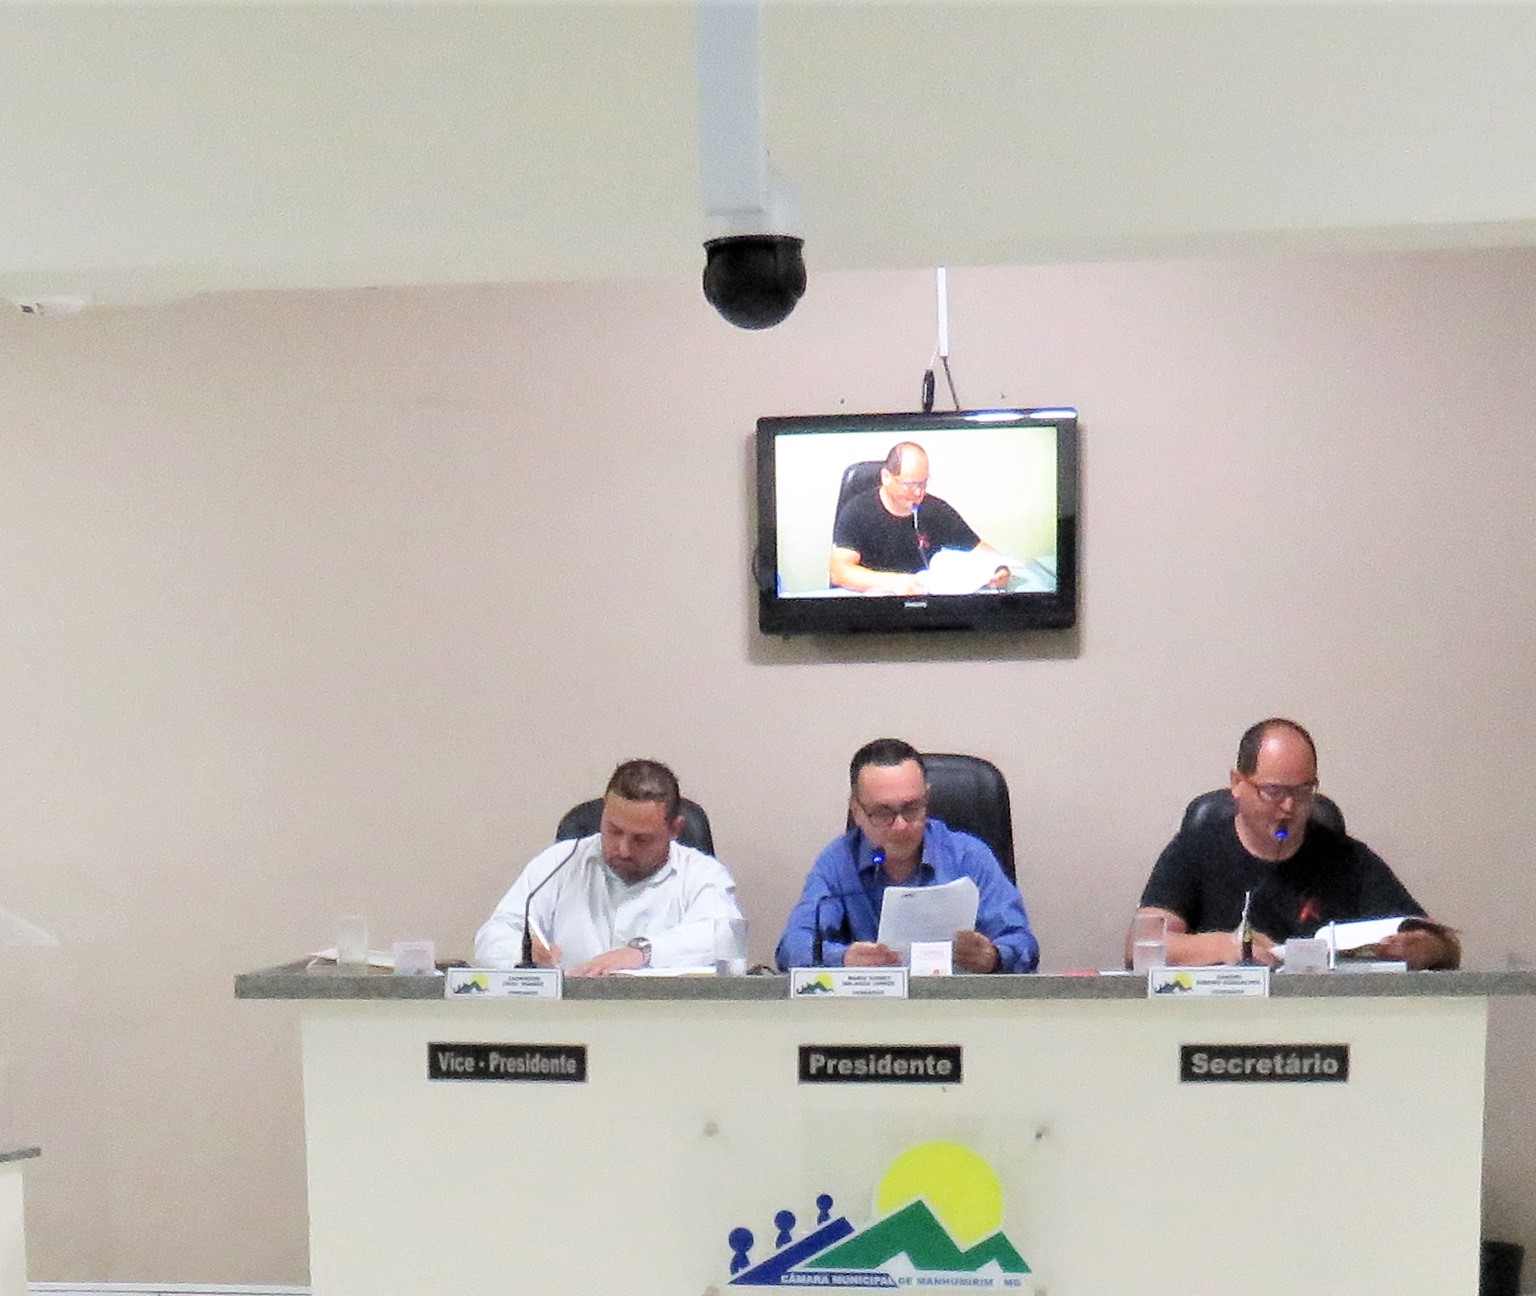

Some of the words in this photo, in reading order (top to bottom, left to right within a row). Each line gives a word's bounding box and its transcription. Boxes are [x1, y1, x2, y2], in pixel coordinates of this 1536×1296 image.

[437, 1051, 475, 1073] Vice
[488, 1051, 577, 1074] Presidente
[809, 1053, 953, 1076] Presidente
[1190, 1052, 1339, 1075] Secretário
[780, 1272, 830, 1285] CÂMARA
[832, 1273, 897, 1287] MUNICIPAL
